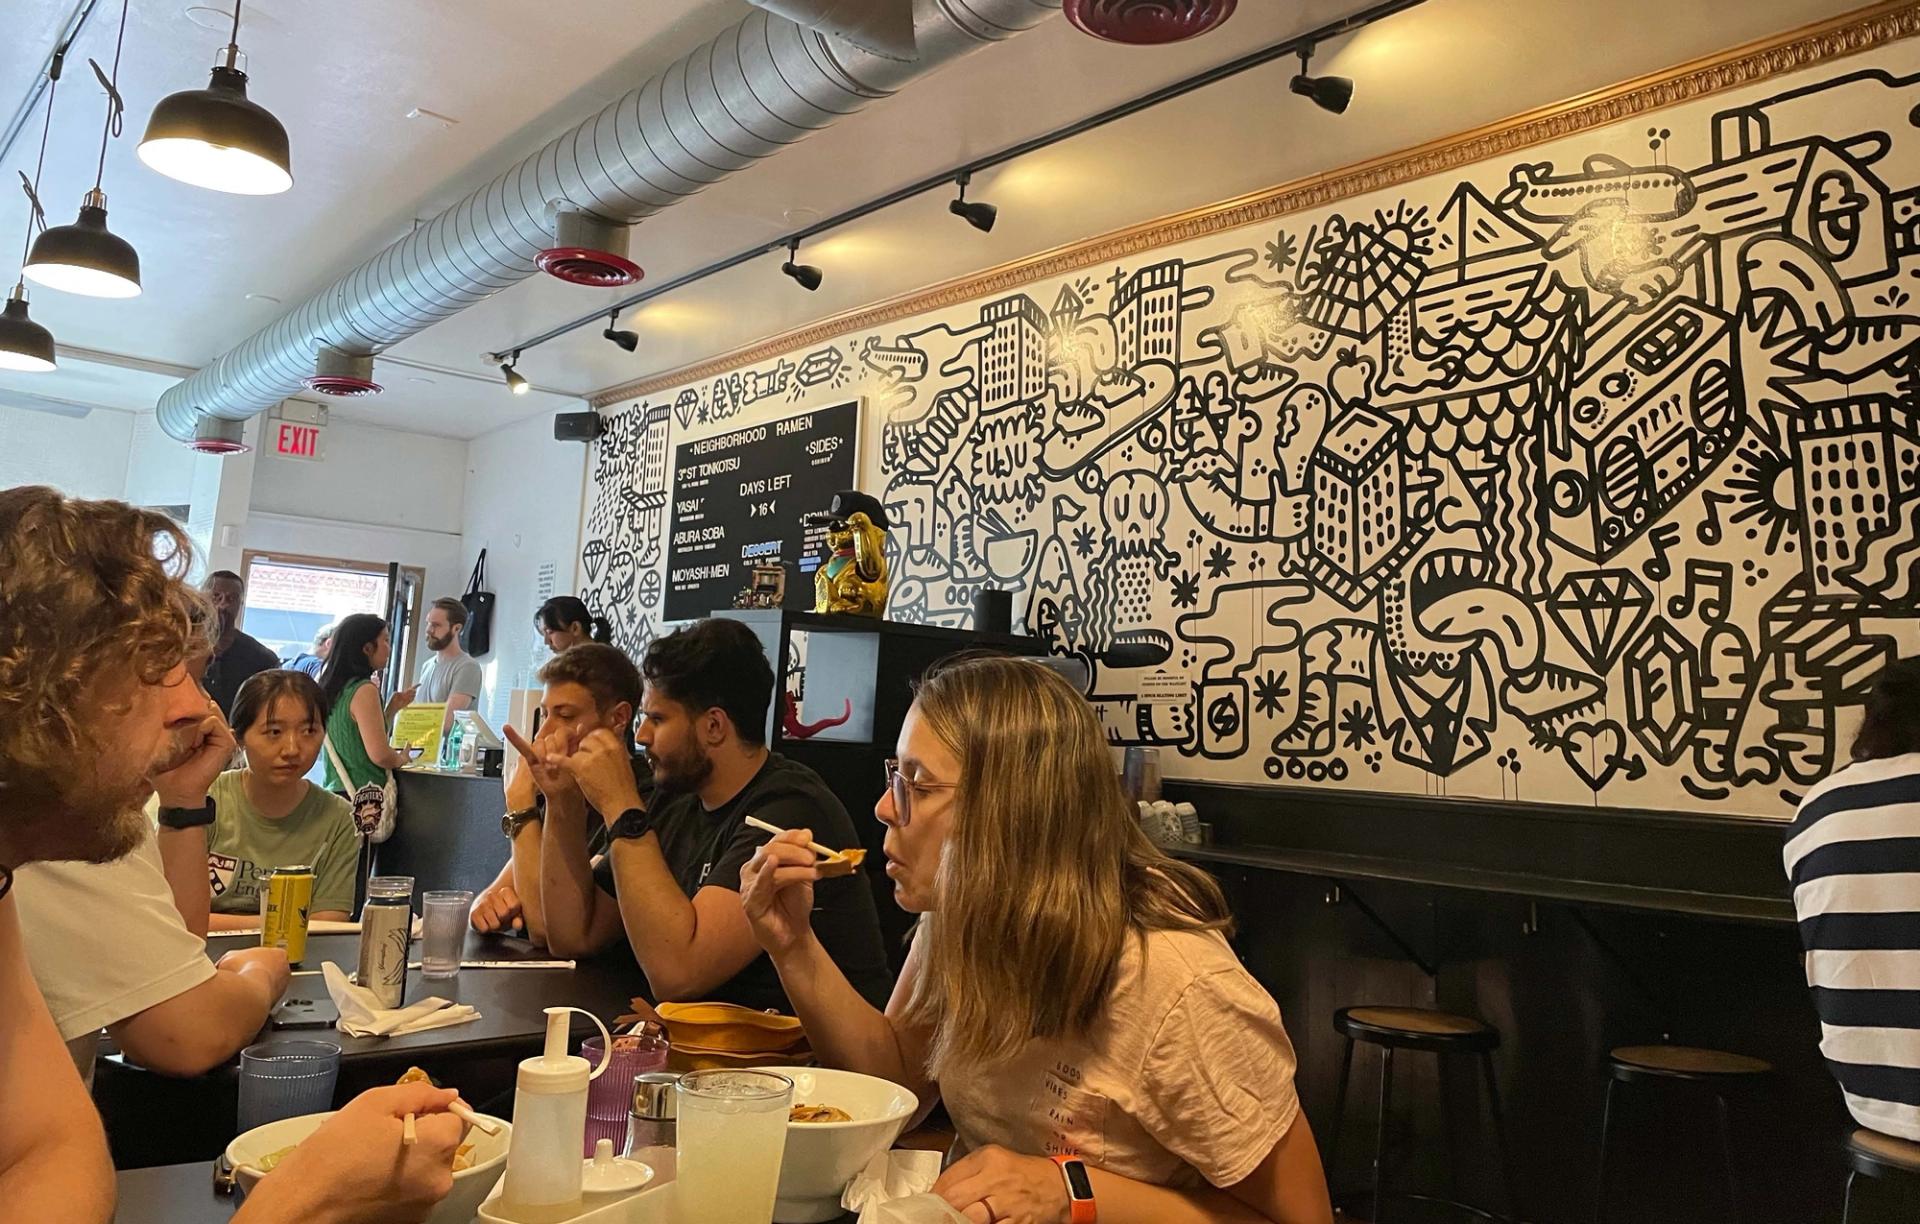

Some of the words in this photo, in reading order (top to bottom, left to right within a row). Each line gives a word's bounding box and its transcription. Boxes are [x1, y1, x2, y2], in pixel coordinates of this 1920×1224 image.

[278, 424, 320, 457] EXIT
[693, 427, 767, 456] NEIGHBORHOOD
[776, 415, 814, 437] RAMEN
[809, 436, 839, 455] SIDES
[686, 466, 698, 480] ST
[699, 456, 741, 477] TONKOTSU
[740, 480, 766, 497] DAYS
[767, 474, 792, 492] LEFT
[758, 503, 769, 517] 16
[673, 529, 702, 545] ABURA
[702, 525, 725, 541] SOBA
[1045, 1079, 1068, 1100] VIBES
[1049, 1108, 1074, 1126] RAIN
